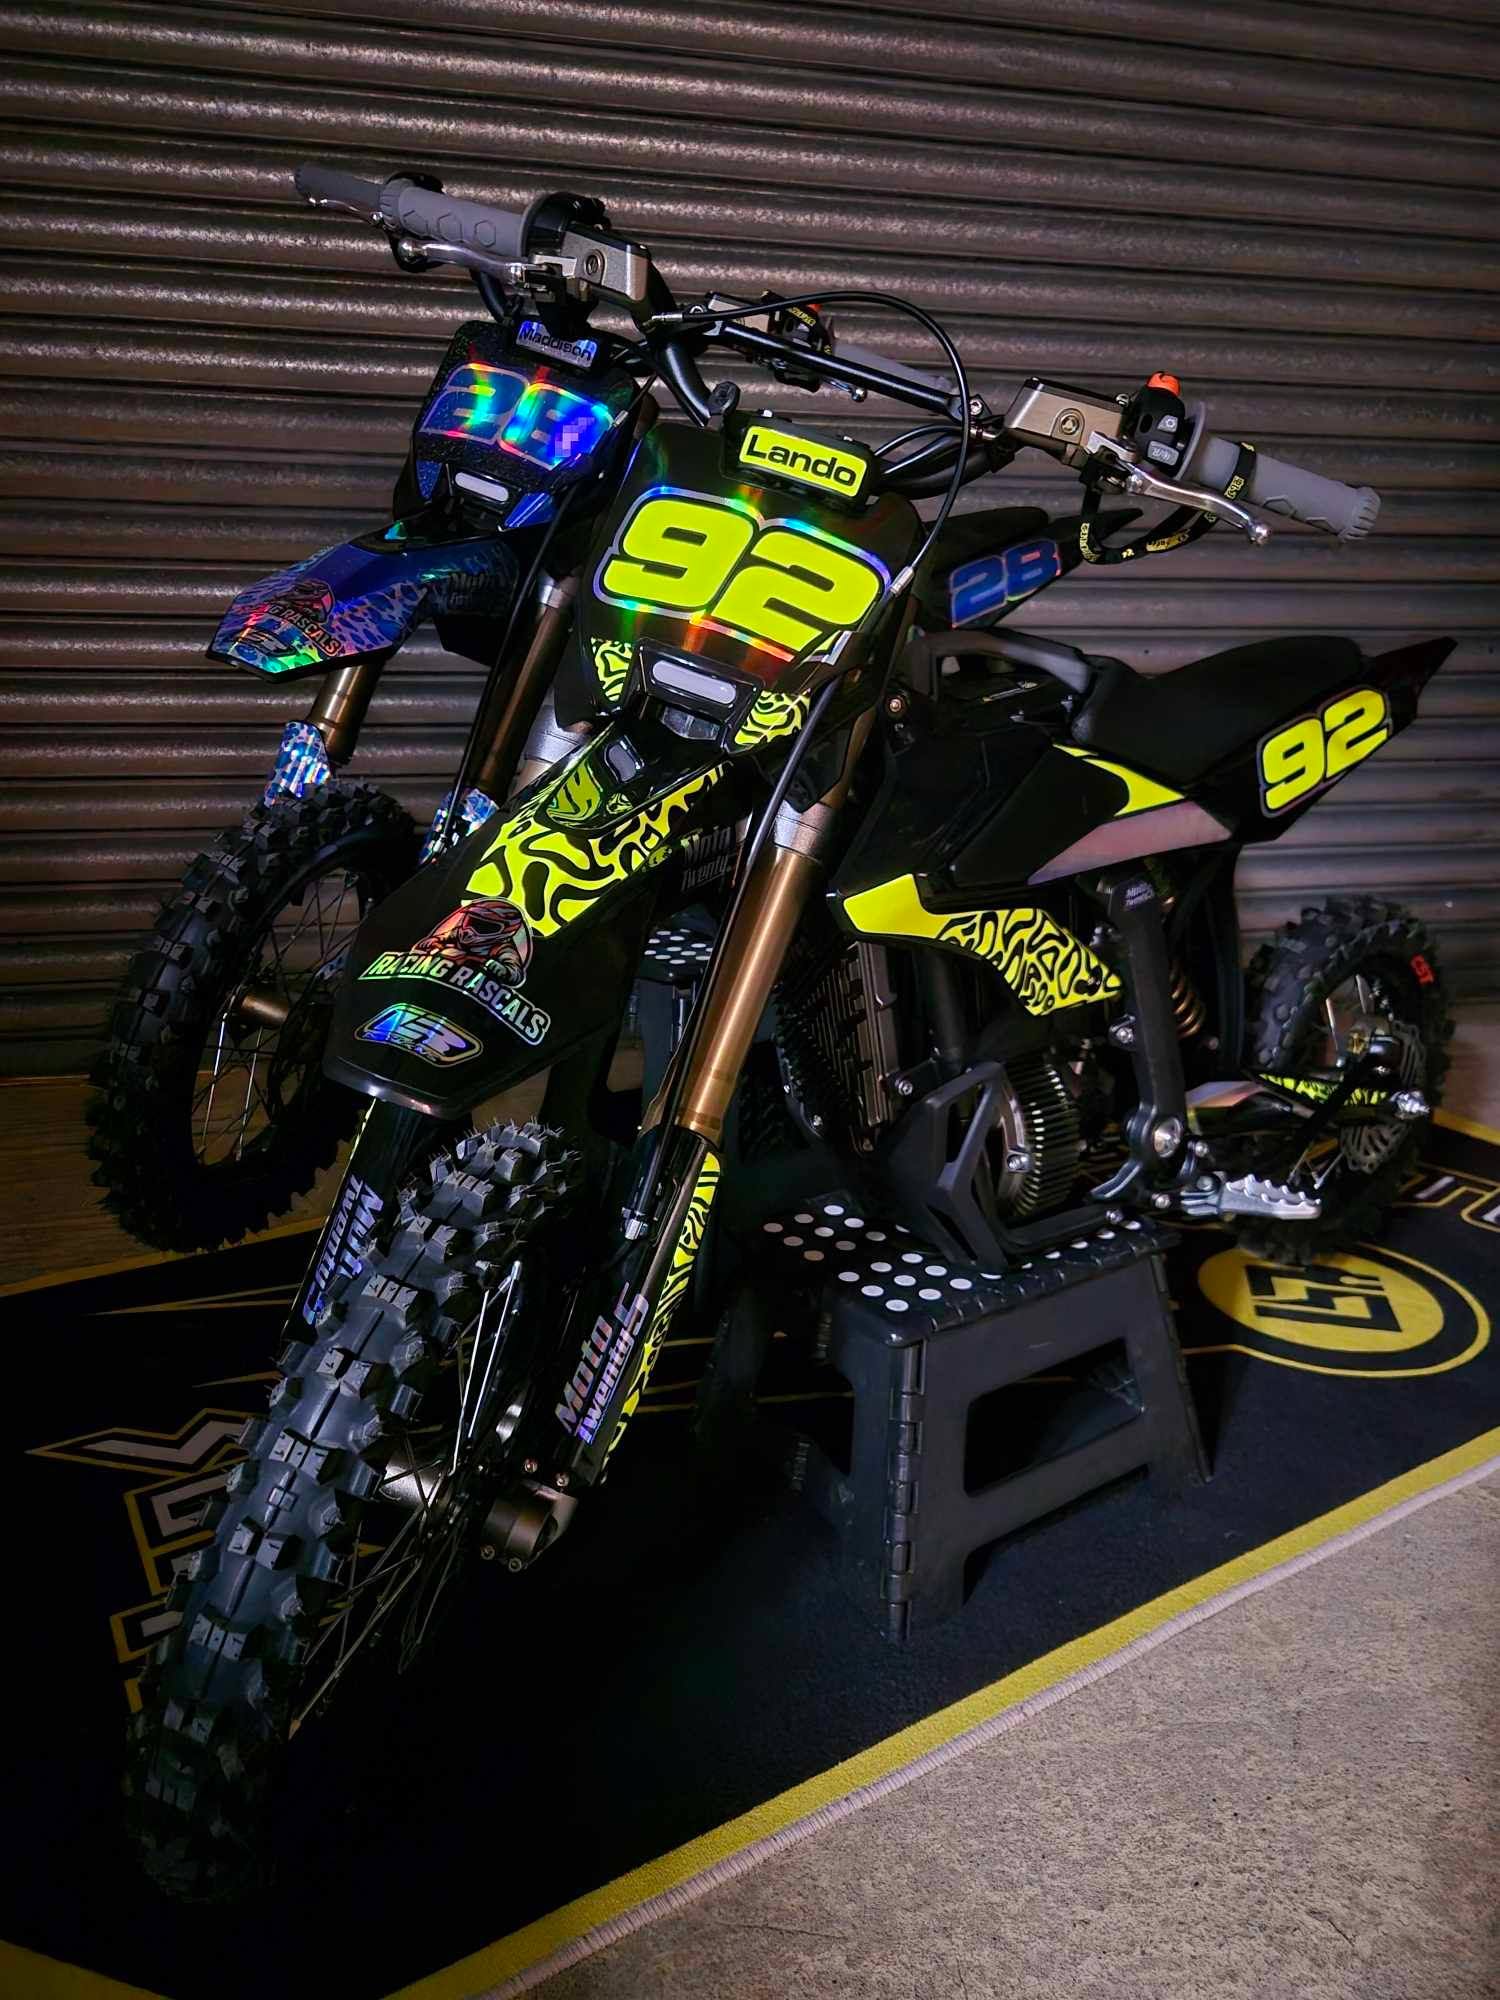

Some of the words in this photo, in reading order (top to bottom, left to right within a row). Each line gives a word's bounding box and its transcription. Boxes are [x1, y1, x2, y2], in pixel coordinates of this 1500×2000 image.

[519, 327, 592, 361] Maddison
[746, 434, 856, 487] Lando
[603, 499, 880, 652] 92
[950, 539, 1061, 627] 28
[280, 608, 340, 655] RASCALS
[1262, 688, 1389, 812] 92
[369, 953, 453, 978] RACING
[451, 965, 545, 1040] RASCALS
[554, 1314, 613, 1434] Moto
[574, 1327, 635, 1445] Twenty
